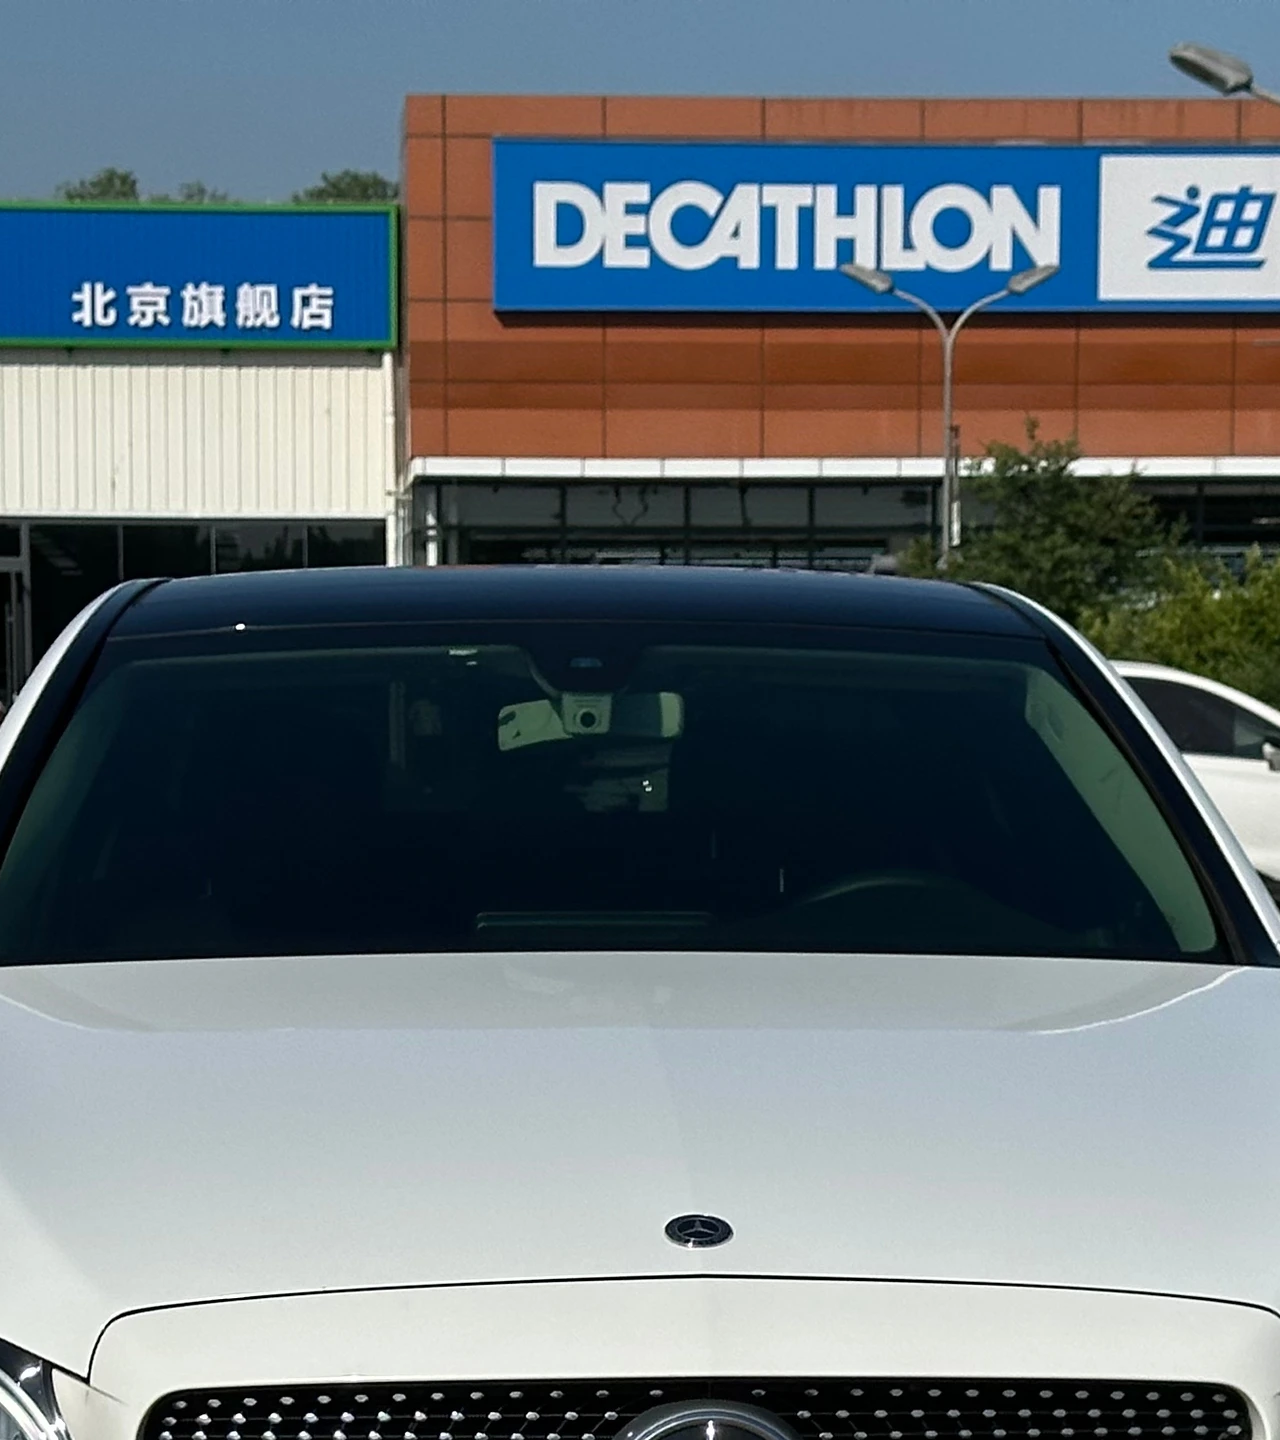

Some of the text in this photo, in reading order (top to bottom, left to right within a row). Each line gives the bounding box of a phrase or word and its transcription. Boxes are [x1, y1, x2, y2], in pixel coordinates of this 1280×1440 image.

[532, 180, 1061, 273] DECATHLON
[71, 281, 334, 330] 北京旗舰店
